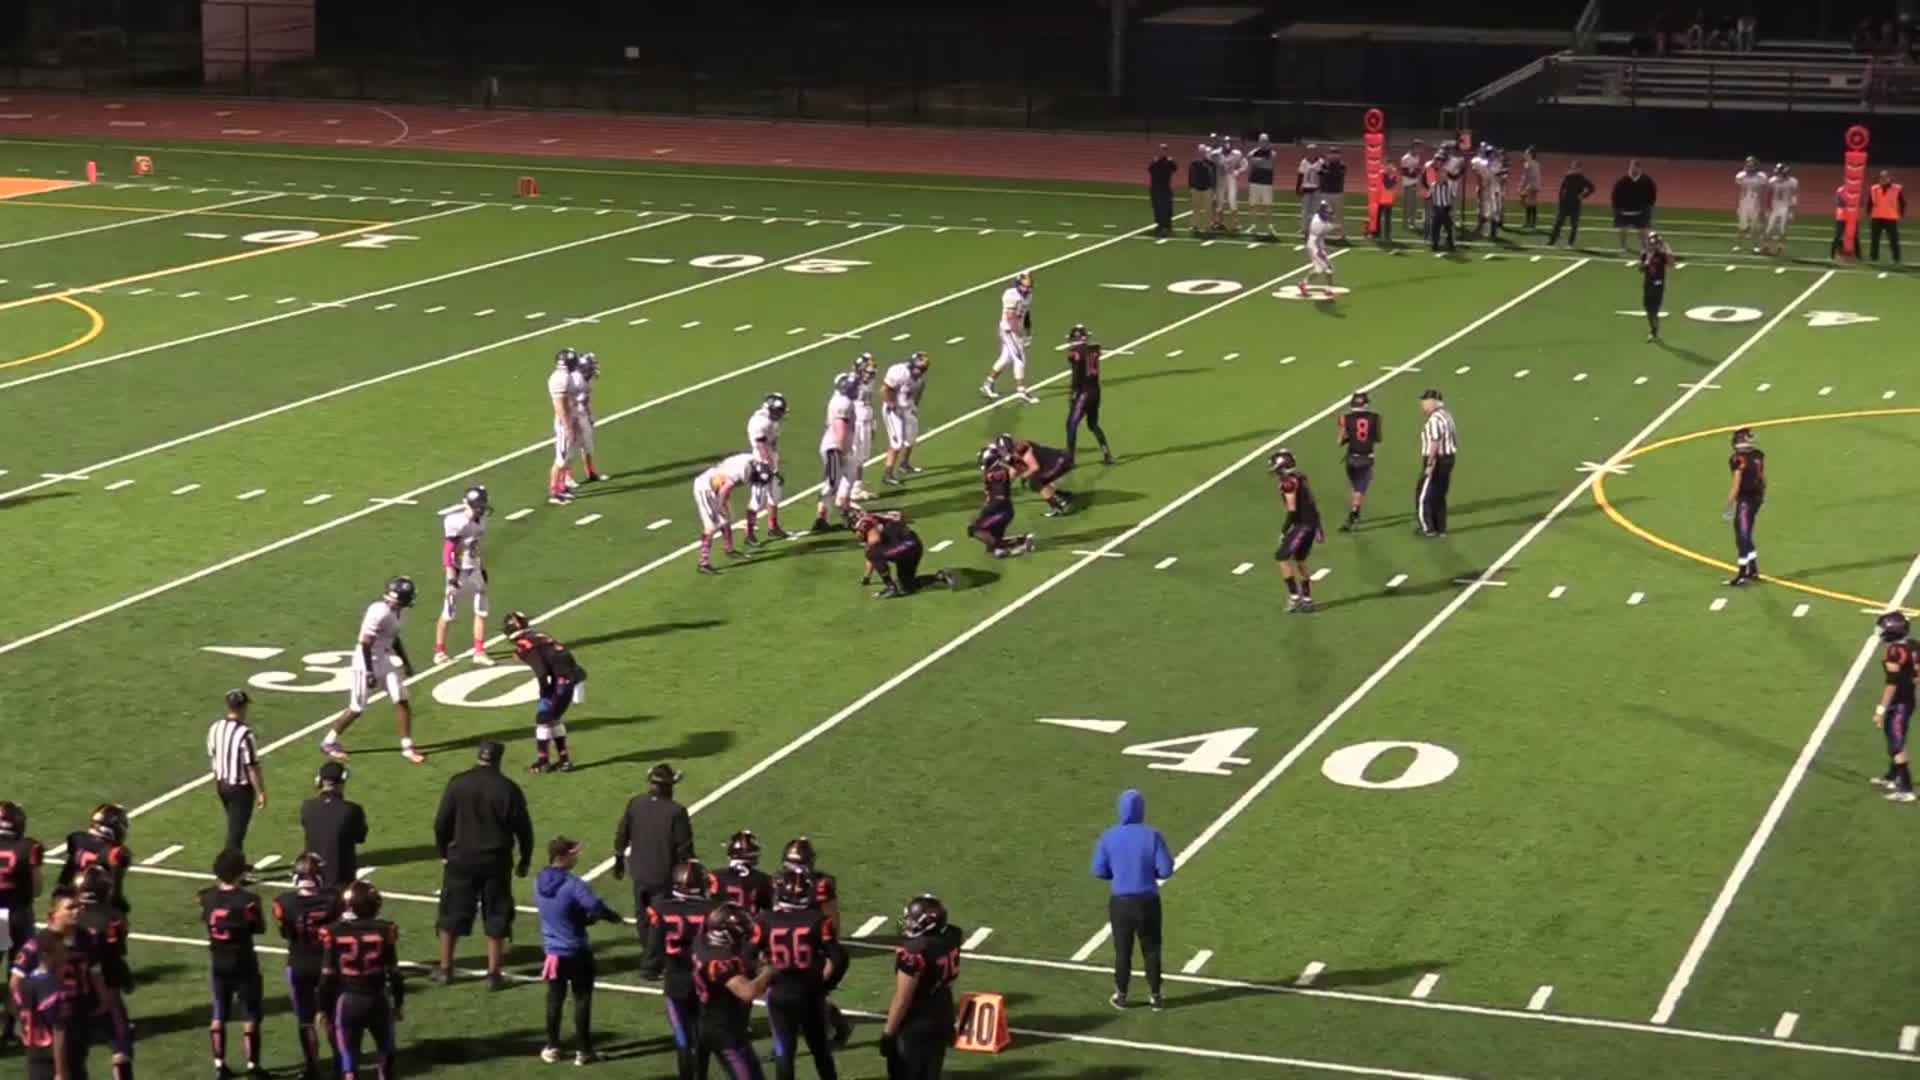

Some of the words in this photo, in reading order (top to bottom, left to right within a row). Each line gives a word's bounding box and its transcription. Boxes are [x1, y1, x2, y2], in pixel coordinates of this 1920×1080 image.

[1684, 306, 1880, 326] 40
[1356, 418, 1369, 442] 8
[248, 649, 541, 707] 30
[1121, 727, 1459, 788] 40
[336, 934, 384, 976] 22
[663, 914, 705, 955] 27
[769, 927, 812, 970] 66
[958, 1000, 996, 1046] 40
